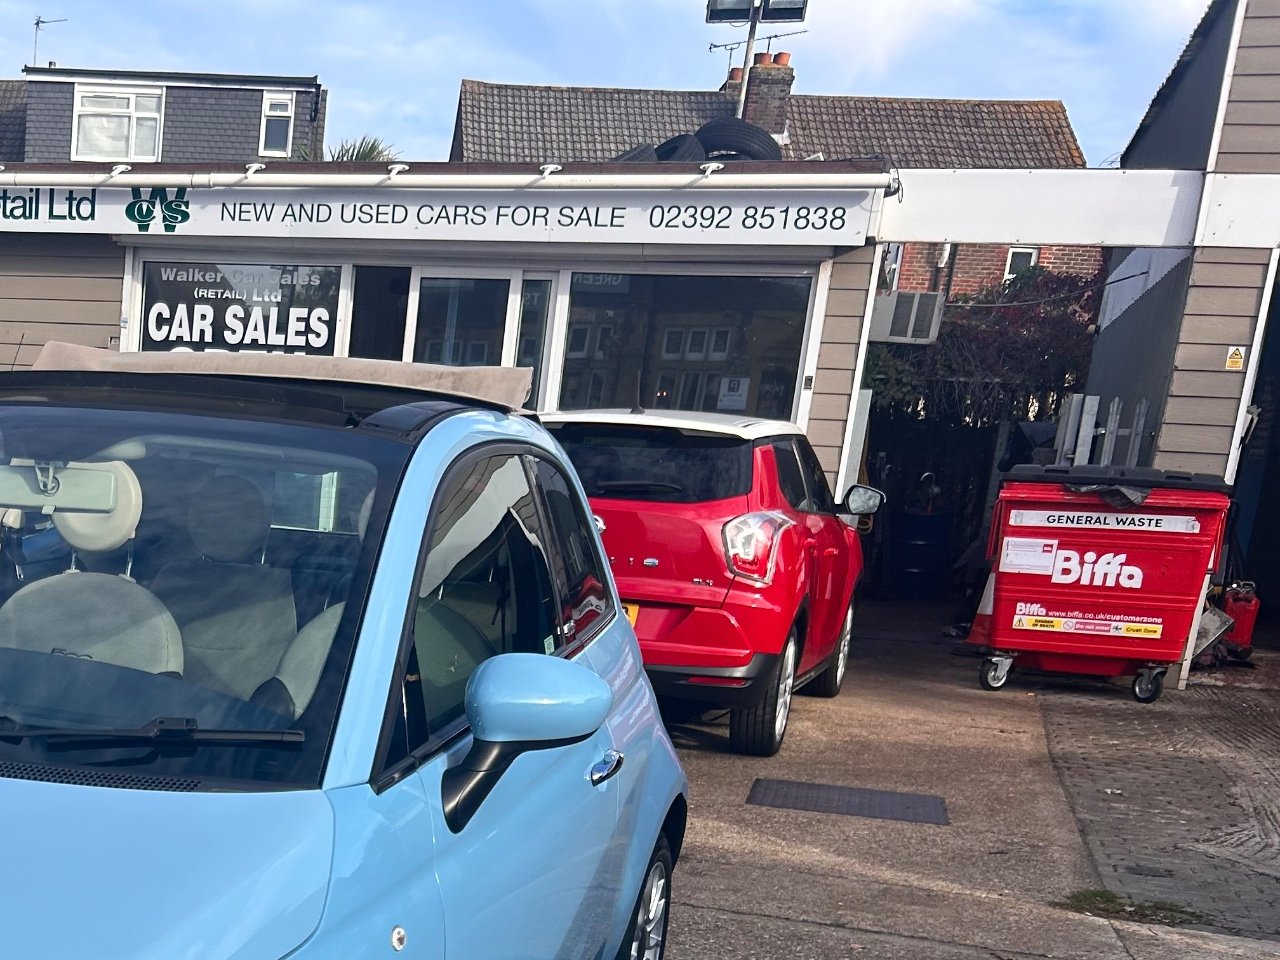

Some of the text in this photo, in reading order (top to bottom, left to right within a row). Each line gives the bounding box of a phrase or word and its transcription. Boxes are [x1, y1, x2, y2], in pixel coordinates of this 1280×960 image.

[49, 188, 96, 221] Ltd
[220, 202, 847, 231] NEW AND USED CARS FOR SALE 02392 851838
[160, 267, 321, 286] Walker Car Sales
[193, 287, 282, 303] (RETAIL) Ltd
[147, 302, 330, 348] CAR SALES
[1046, 514, 1163, 528] GENERAL WASTE
[1051, 550, 1144, 589] Biffa
[1016, 602, 1163, 624] Biffa www.biffa.co.uk/customerzone
